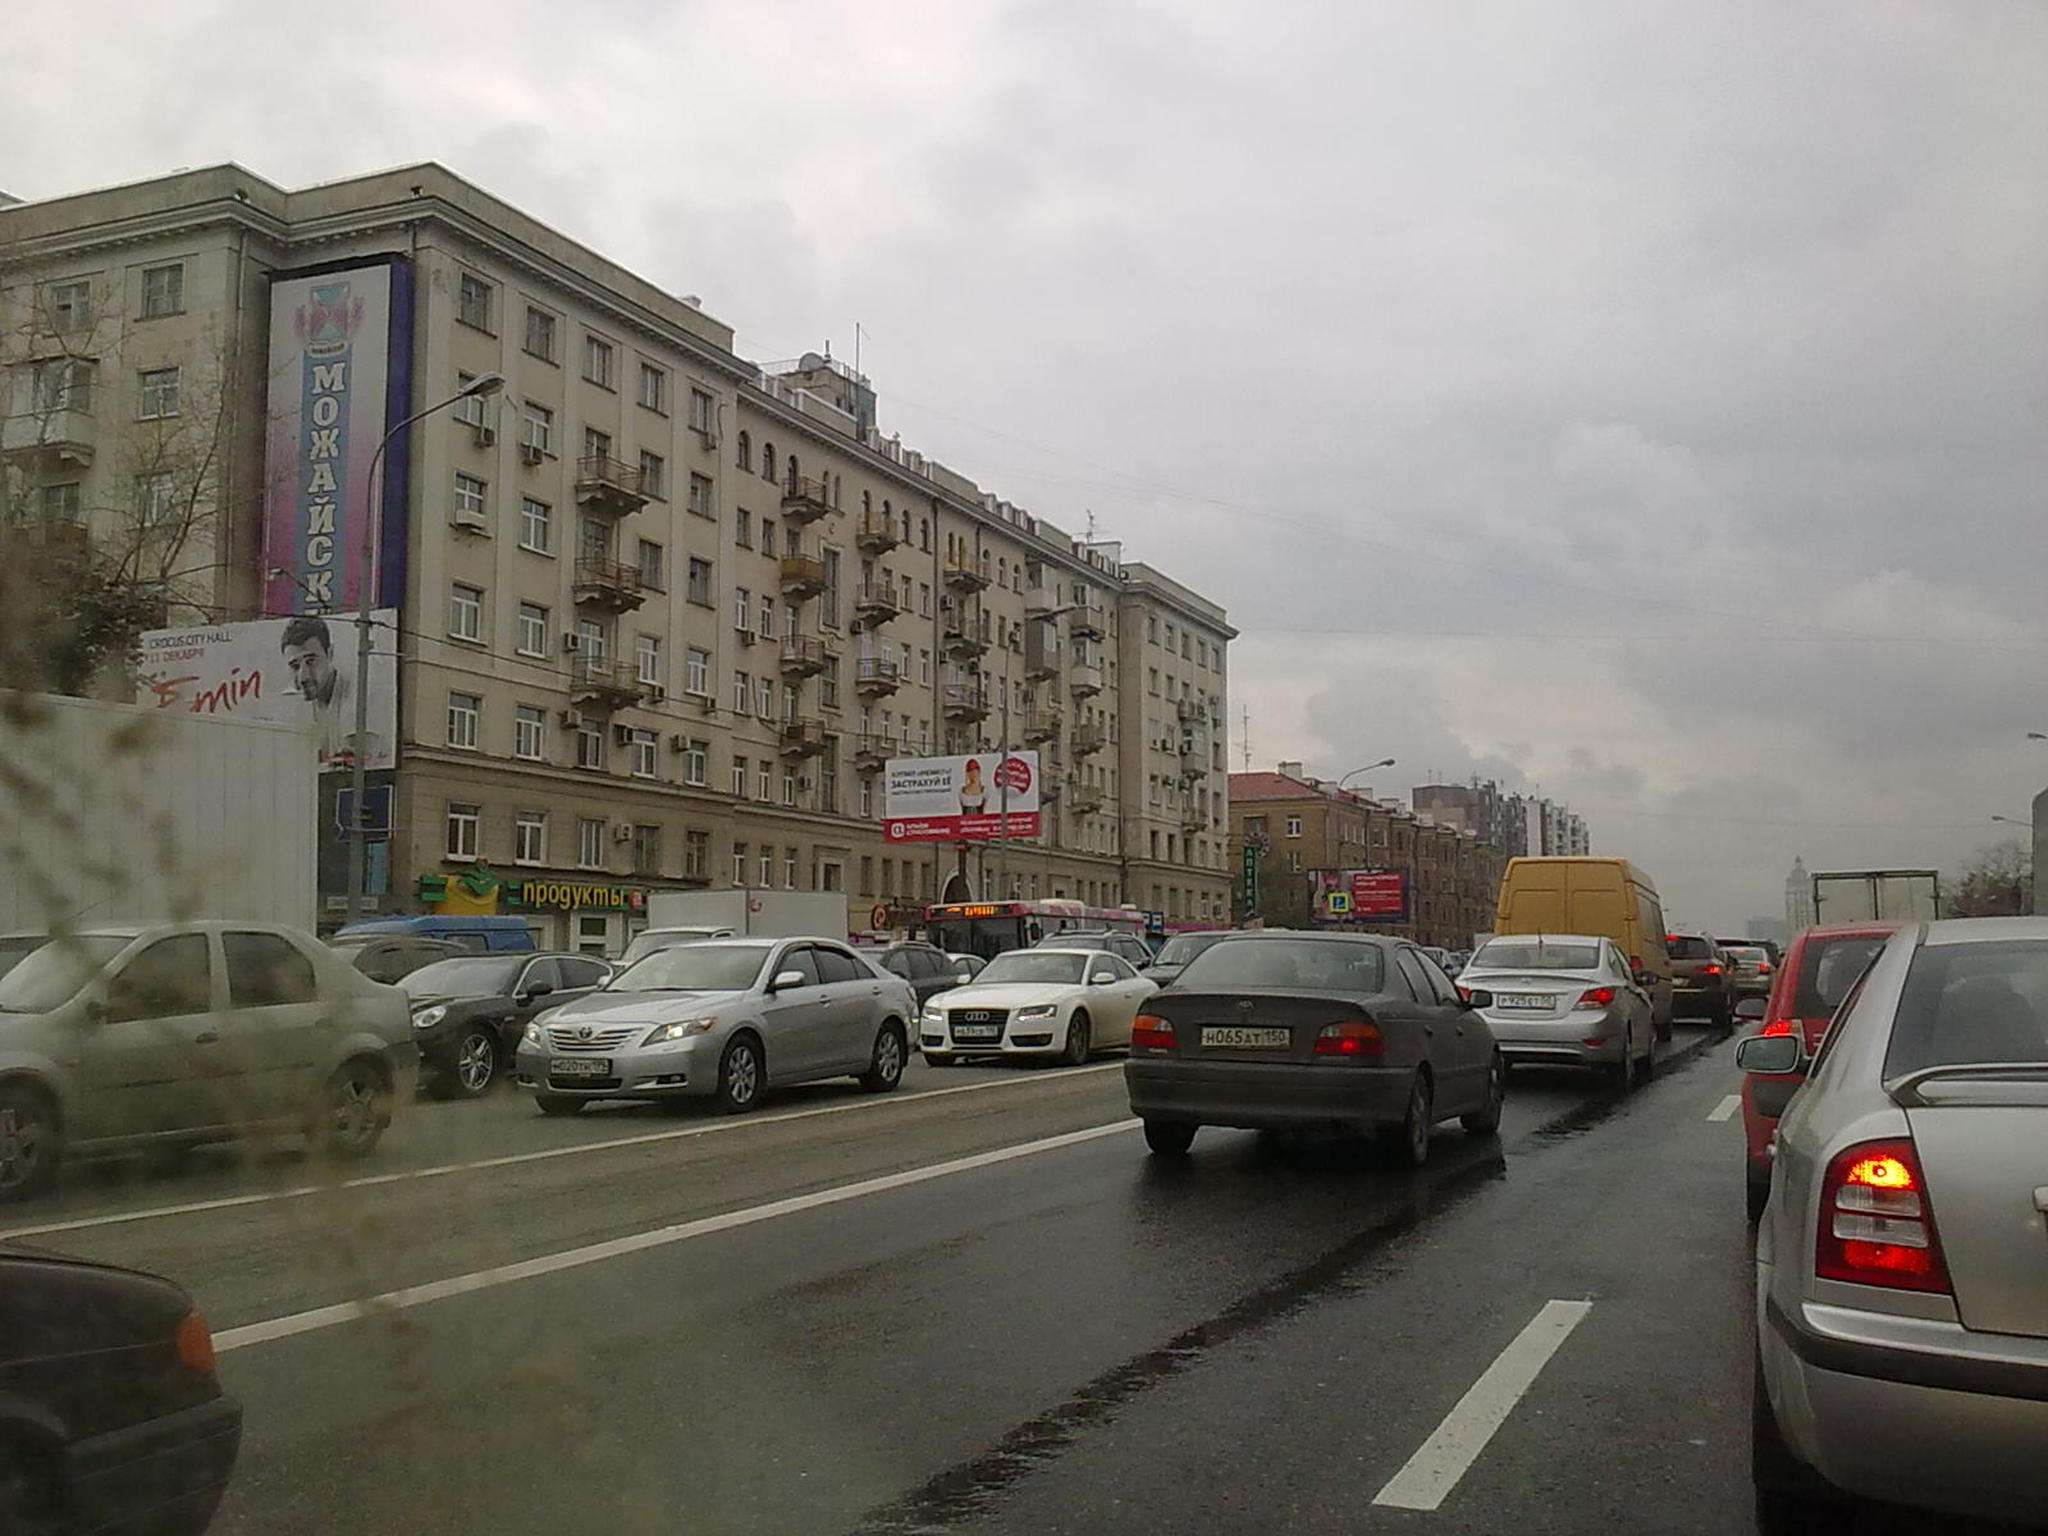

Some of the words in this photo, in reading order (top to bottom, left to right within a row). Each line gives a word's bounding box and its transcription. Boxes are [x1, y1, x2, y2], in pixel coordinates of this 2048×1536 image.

[305, 362, 346, 616] МОЖАЙСК
[207, 630, 232, 643] HALL
[150, 667, 260, 713] Emin
[891, 777, 941, 789] ЗАСТРАХУЙ
[523, 882, 624, 909] продукты
